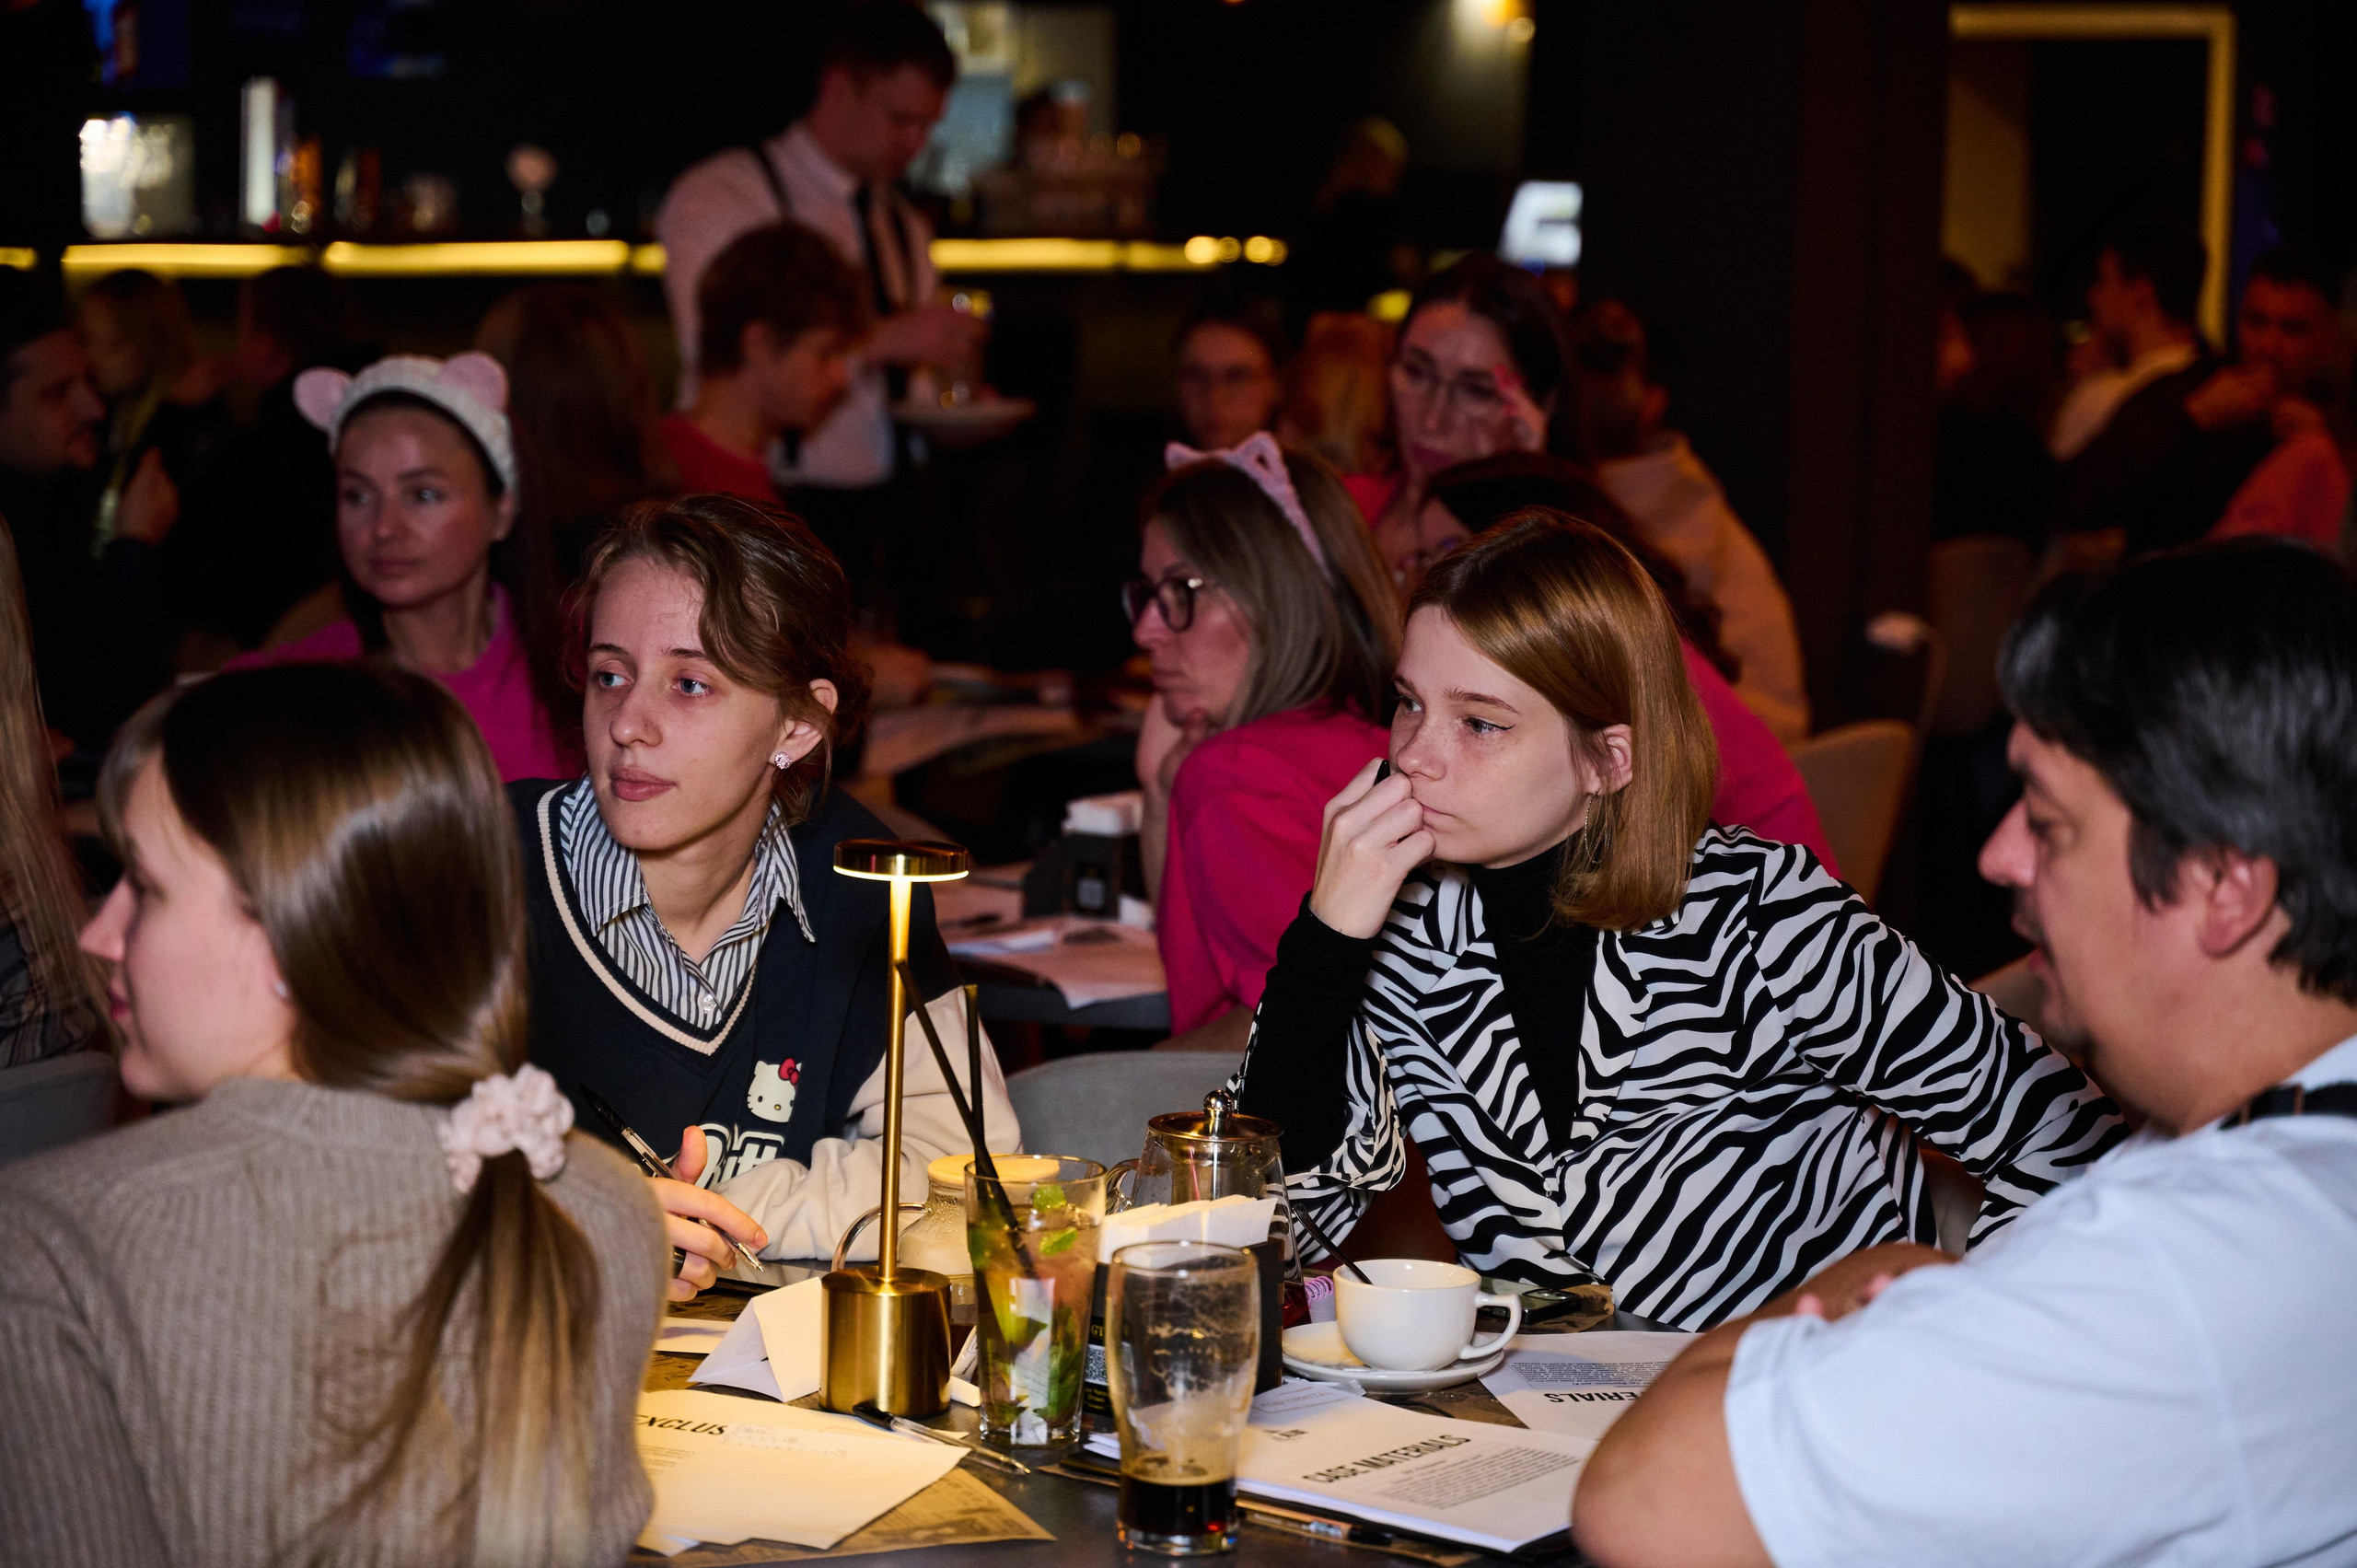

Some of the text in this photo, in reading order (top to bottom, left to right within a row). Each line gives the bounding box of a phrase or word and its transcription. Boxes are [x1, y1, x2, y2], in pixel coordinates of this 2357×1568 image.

[1543, 1390, 1644, 1403] ERIALS
[1302, 1434, 1472, 1483] CASE MATERIALS
